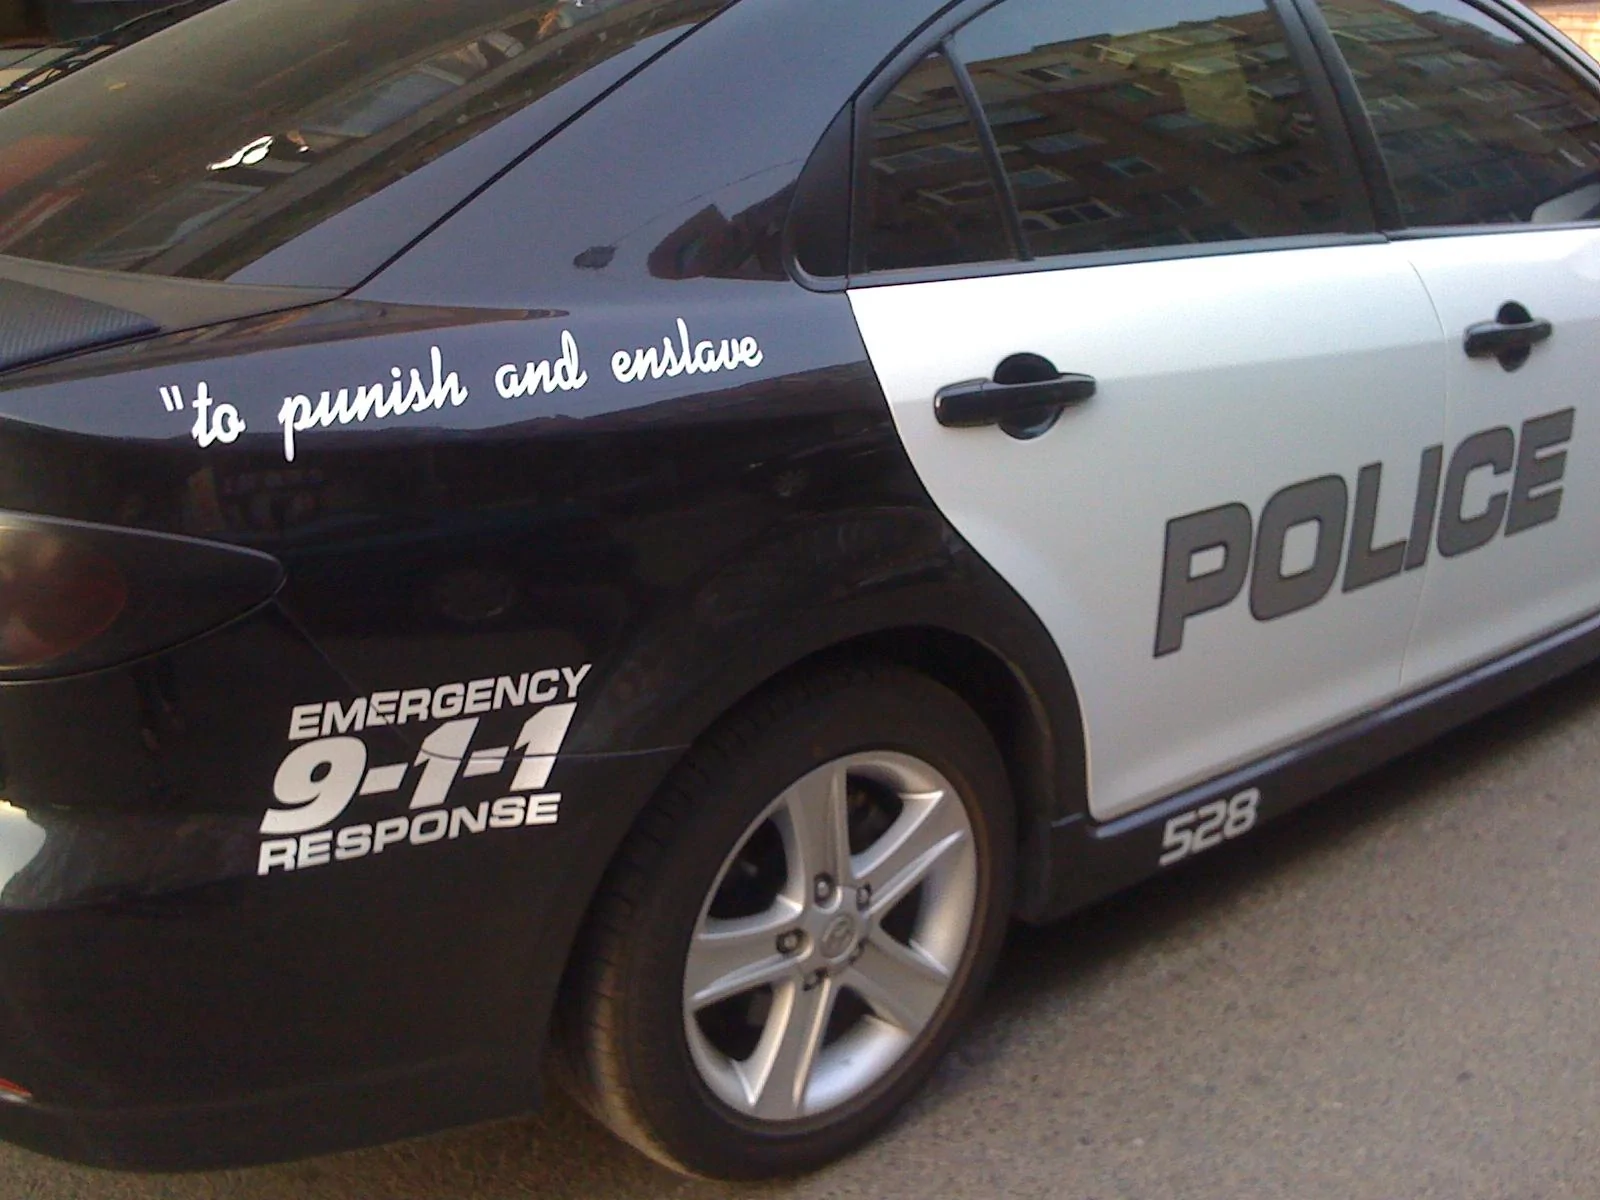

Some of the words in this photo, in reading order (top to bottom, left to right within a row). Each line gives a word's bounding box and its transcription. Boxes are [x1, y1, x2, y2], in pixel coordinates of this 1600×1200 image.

[158, 381, 247, 449] "to
[277, 345, 470, 462] punish
[494, 329, 588, 399] and
[611, 317, 764, 383] enslave
[1153, 406, 1576, 659] POLICE
[288, 663, 592, 740] EMERGENCY
[259, 702, 578, 834] 9-1-1
[257, 792, 562, 876] RESPONSE
[1158, 787, 1261, 867] 528
